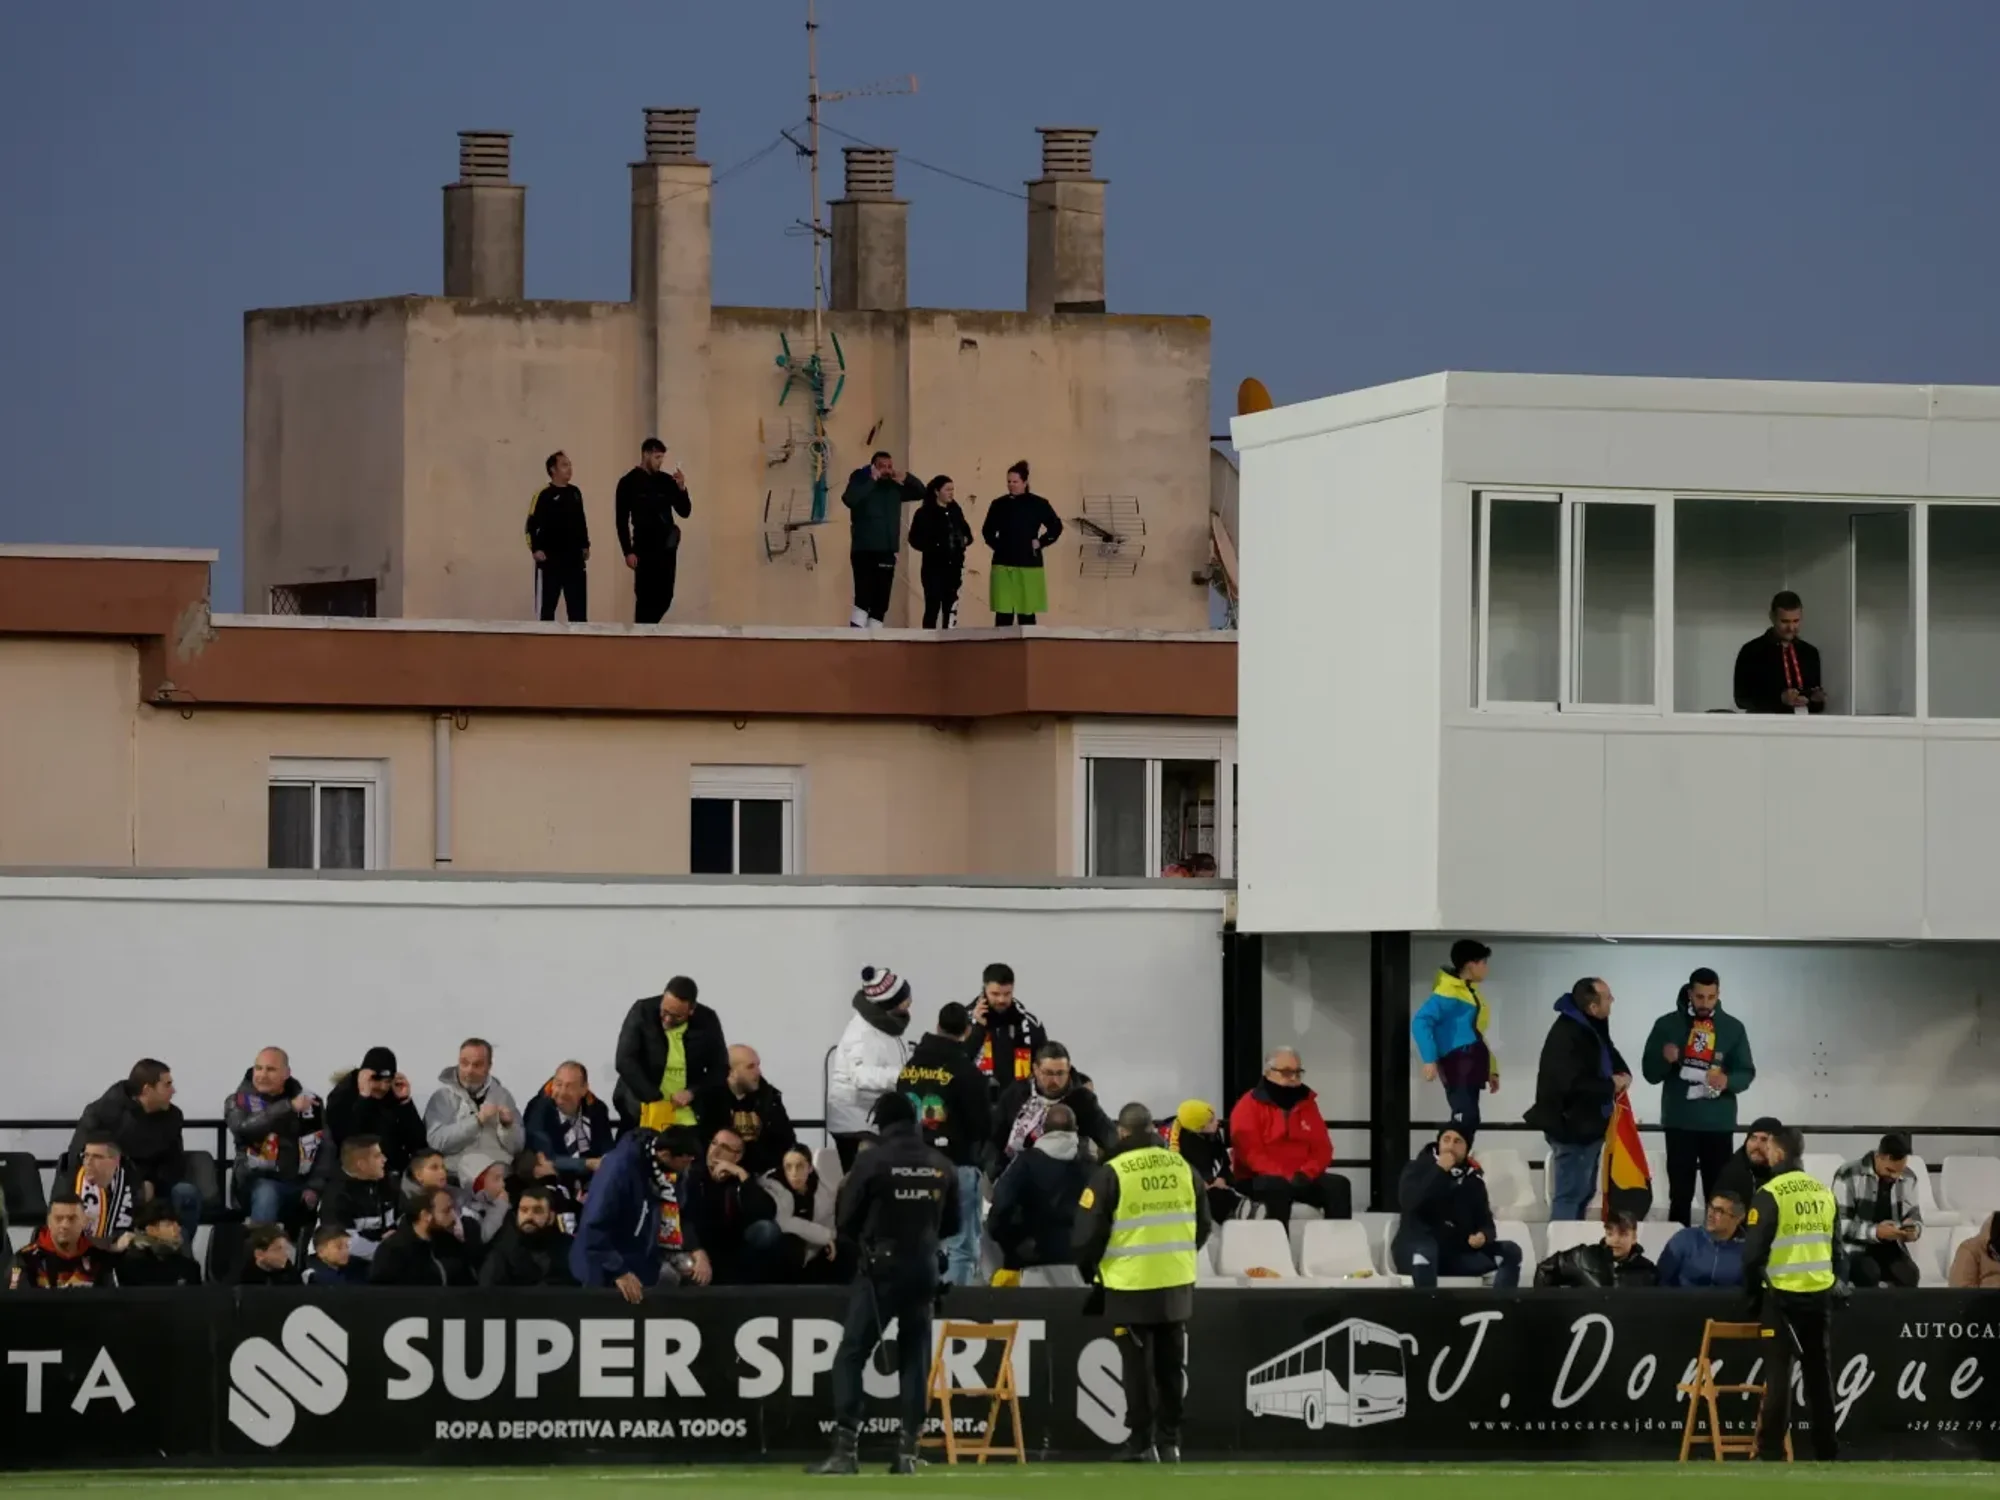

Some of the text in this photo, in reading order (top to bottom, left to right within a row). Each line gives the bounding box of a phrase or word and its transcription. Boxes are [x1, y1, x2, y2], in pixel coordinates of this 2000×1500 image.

[1120, 1154, 1184, 1173] SEGURIDAD
[1141, 1174, 1178, 1191] 0023
[1795, 1200, 1826, 1216] 0017
[383, 1316, 706, 1401] SUPER
[1428, 1310, 1510, 1409] J.
[7, 1346, 136, 1414] TA
[435, 1418, 747, 1439] ROPA DEPORTIVA PARA TODOS
[1907, 1420, 1929, 1431] +34
[1937, 1420, 1960, 1431] 952
[1967, 1420, 1983, 1431] 79
